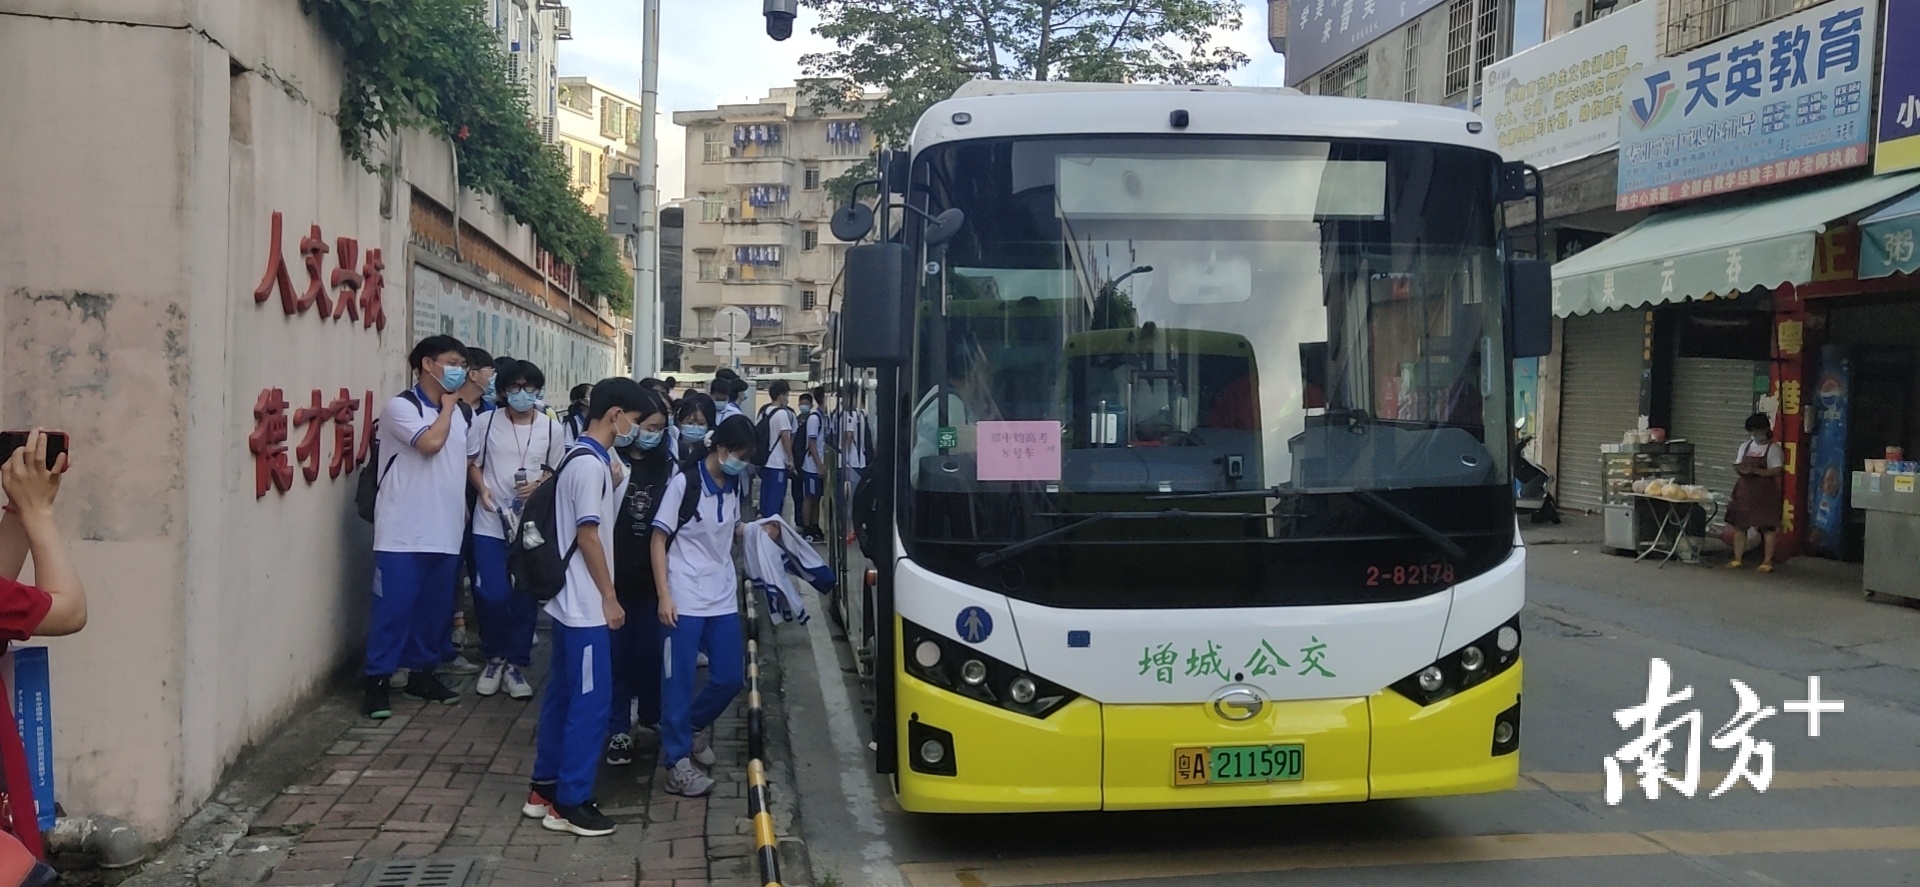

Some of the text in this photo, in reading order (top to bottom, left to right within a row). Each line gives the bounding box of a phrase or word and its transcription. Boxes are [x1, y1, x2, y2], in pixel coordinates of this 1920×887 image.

[1684, 7, 1864, 117] 天英教育
[254, 210, 386, 332] 人文兴校
[1883, 229, 1914, 266] 粥
[1366, 563, 1455, 586] 2-82178
[1138, 635, 1337, 685] 增城公交
